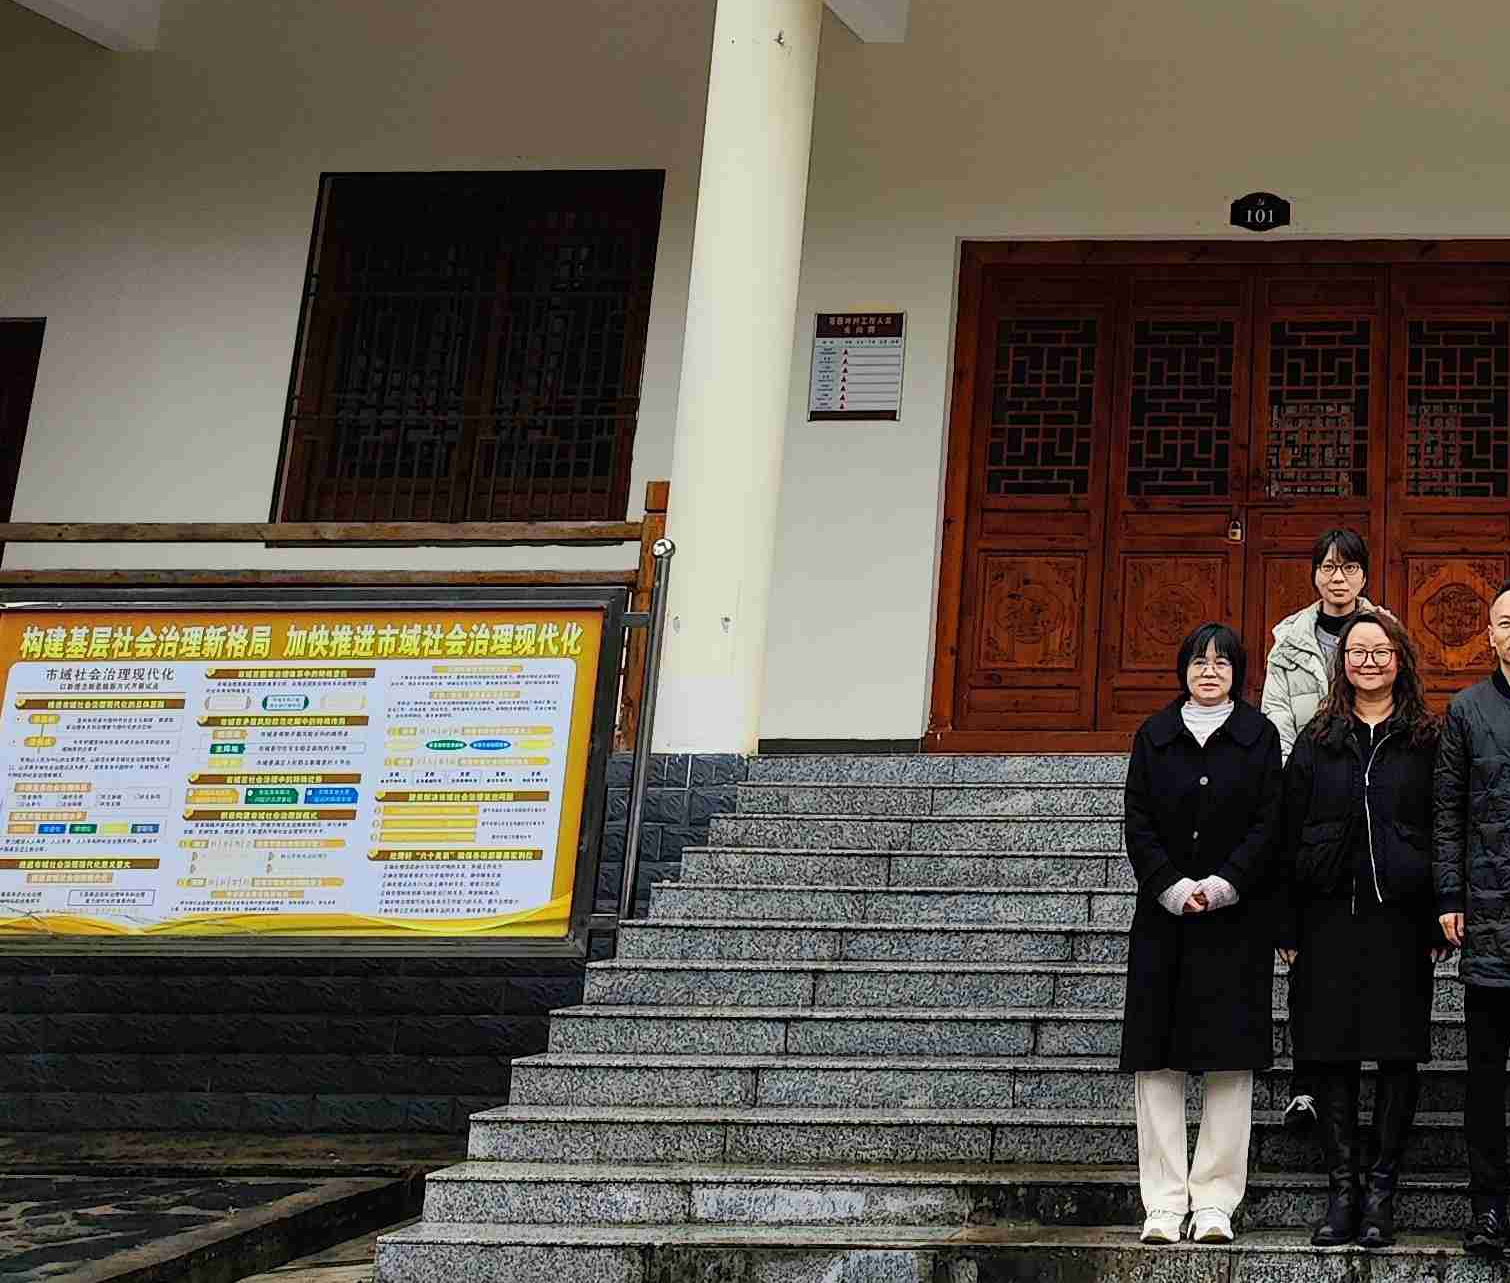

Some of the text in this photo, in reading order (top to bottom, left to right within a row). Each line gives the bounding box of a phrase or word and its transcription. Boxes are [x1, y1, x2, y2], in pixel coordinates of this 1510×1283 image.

[1247, 208, 1273, 223] 101
[20, 621, 584, 659] 构建基层社会治理新格局 加快推进市域社会治理现代化
[46, 667, 175, 681] 市域社会治理现代化
